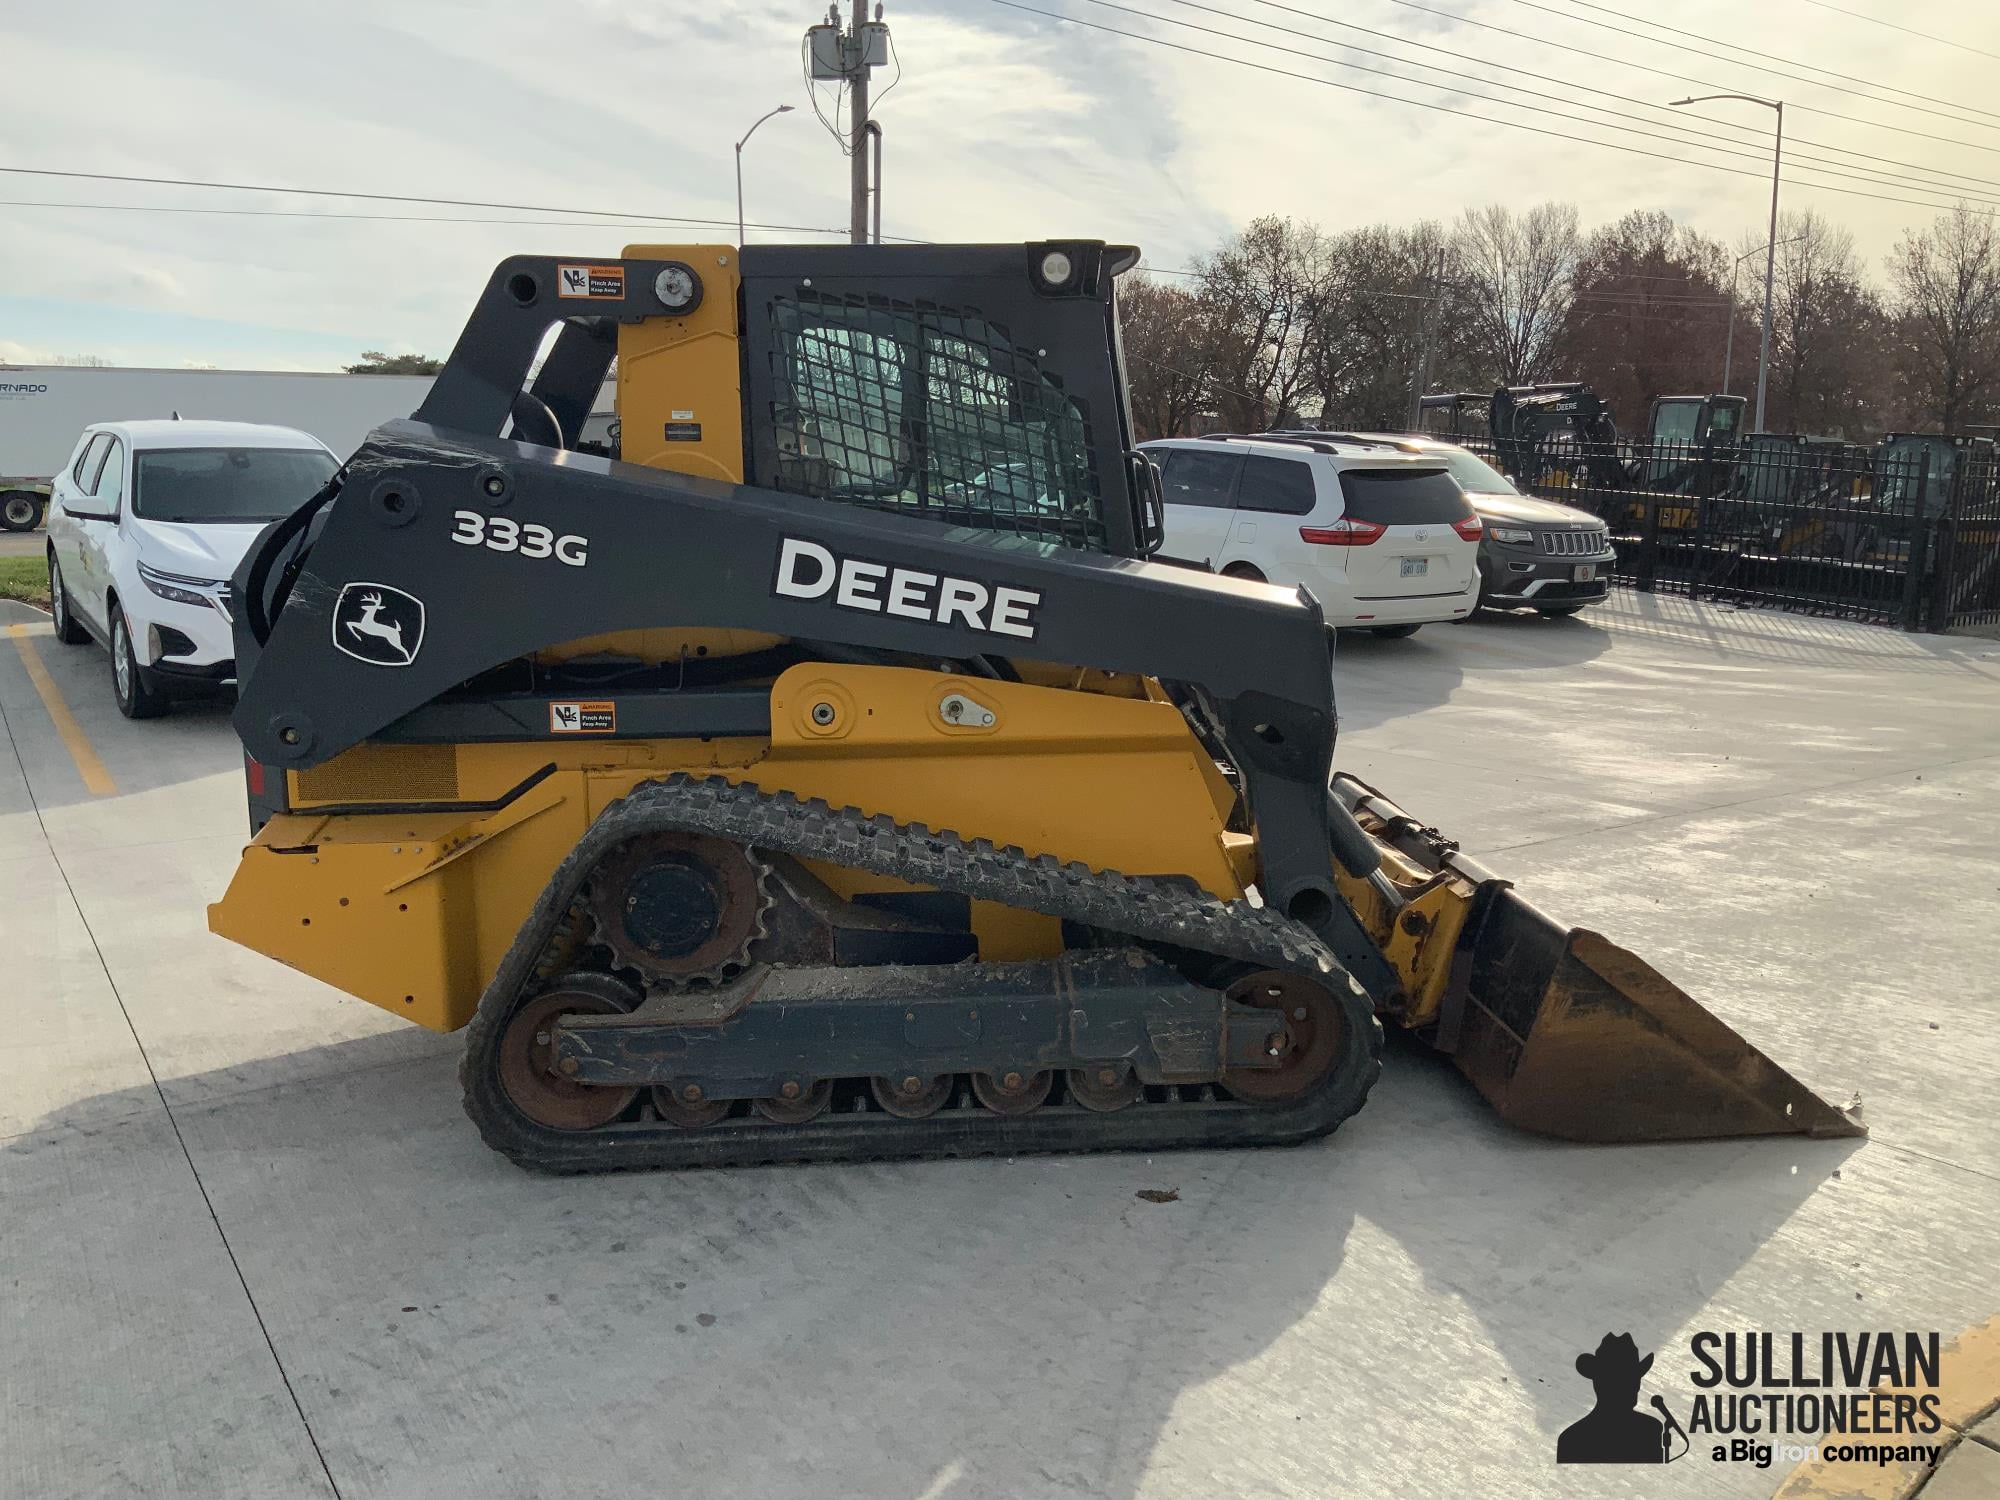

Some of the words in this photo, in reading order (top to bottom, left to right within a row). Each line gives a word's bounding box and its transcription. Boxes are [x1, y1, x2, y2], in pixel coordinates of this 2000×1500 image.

[1557, 402, 1577, 411] DEERE
[452, 510, 589, 566] 333G
[776, 538, 1041, 639] DEERE
